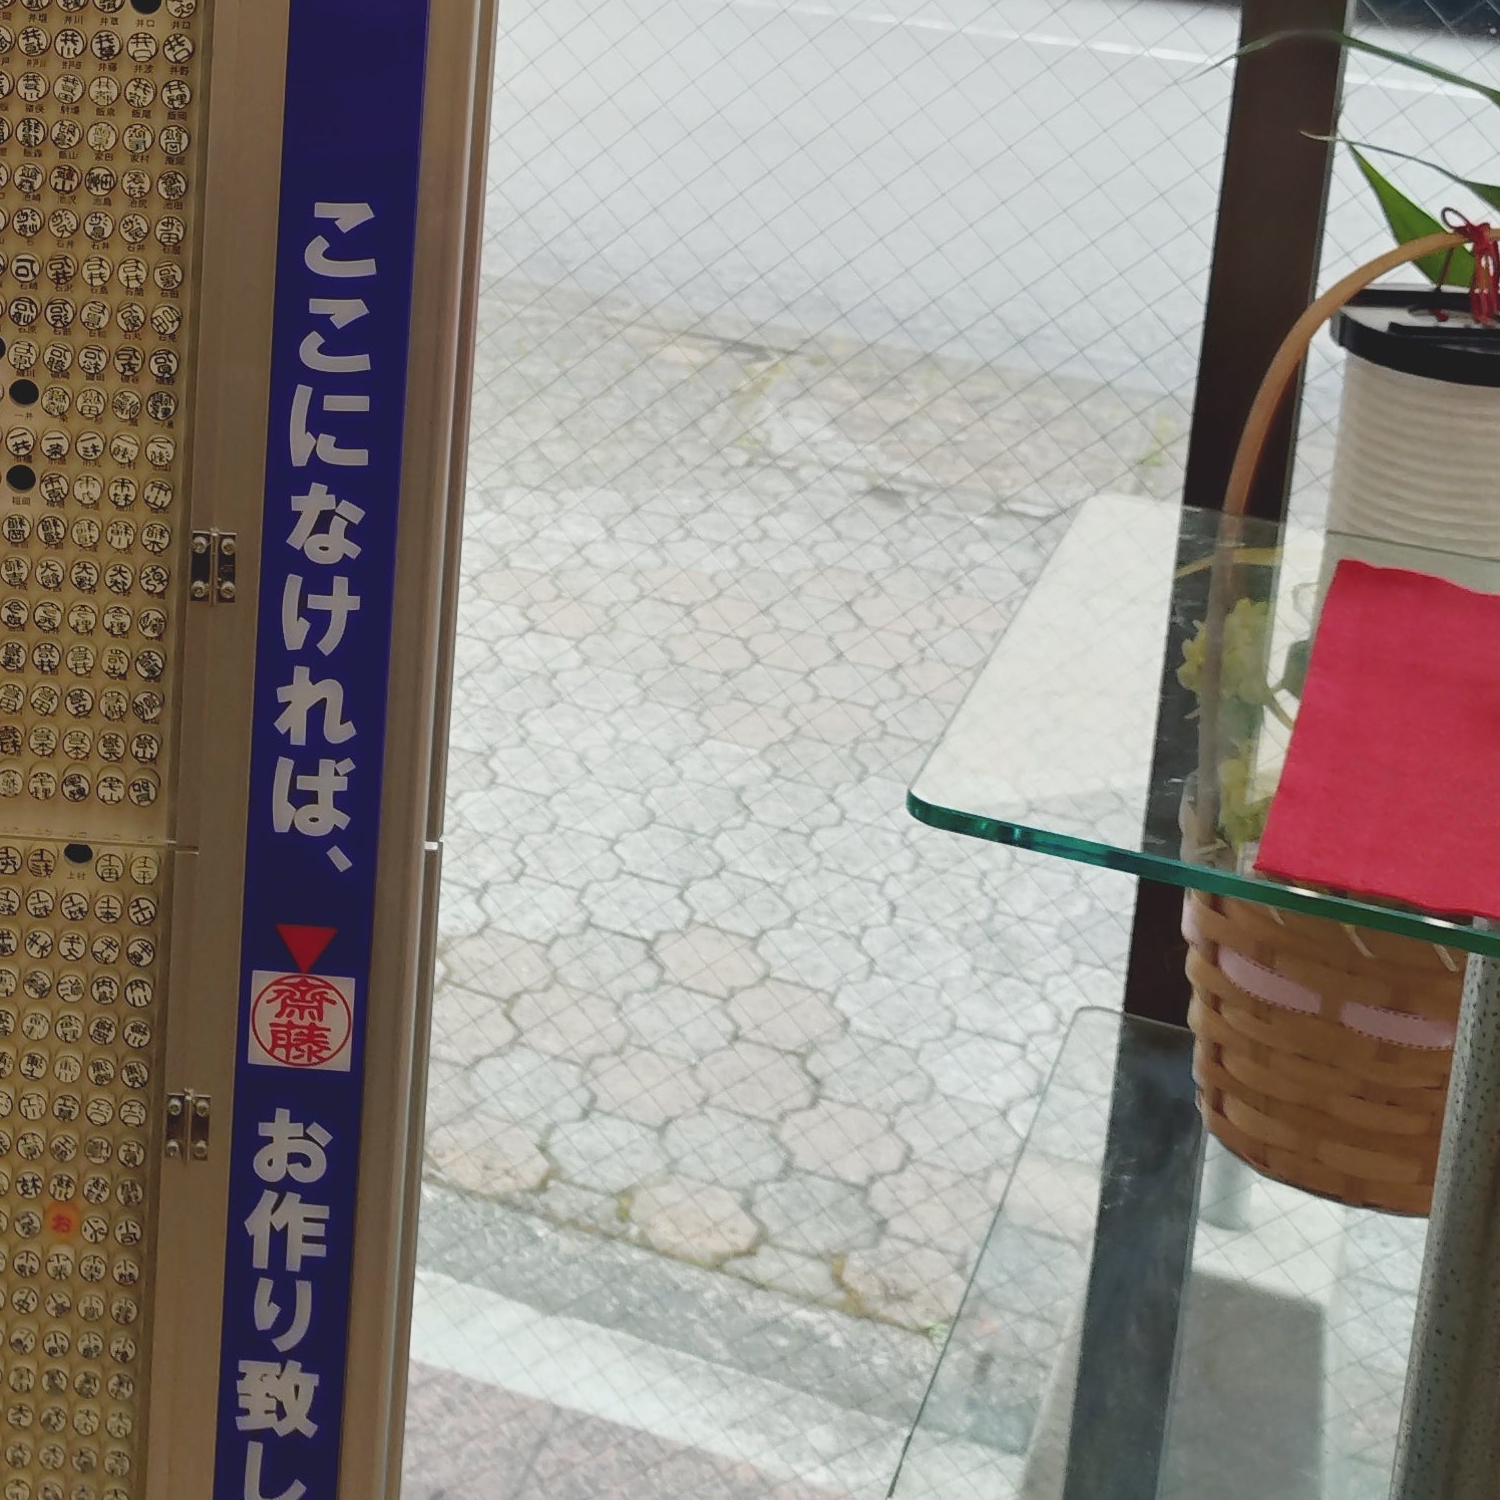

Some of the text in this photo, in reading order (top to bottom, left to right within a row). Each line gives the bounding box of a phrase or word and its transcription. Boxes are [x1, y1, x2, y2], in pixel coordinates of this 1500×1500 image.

[271, 200, 378, 874] ここになければ、
[235, 1106, 334, 1500] お作り致し
